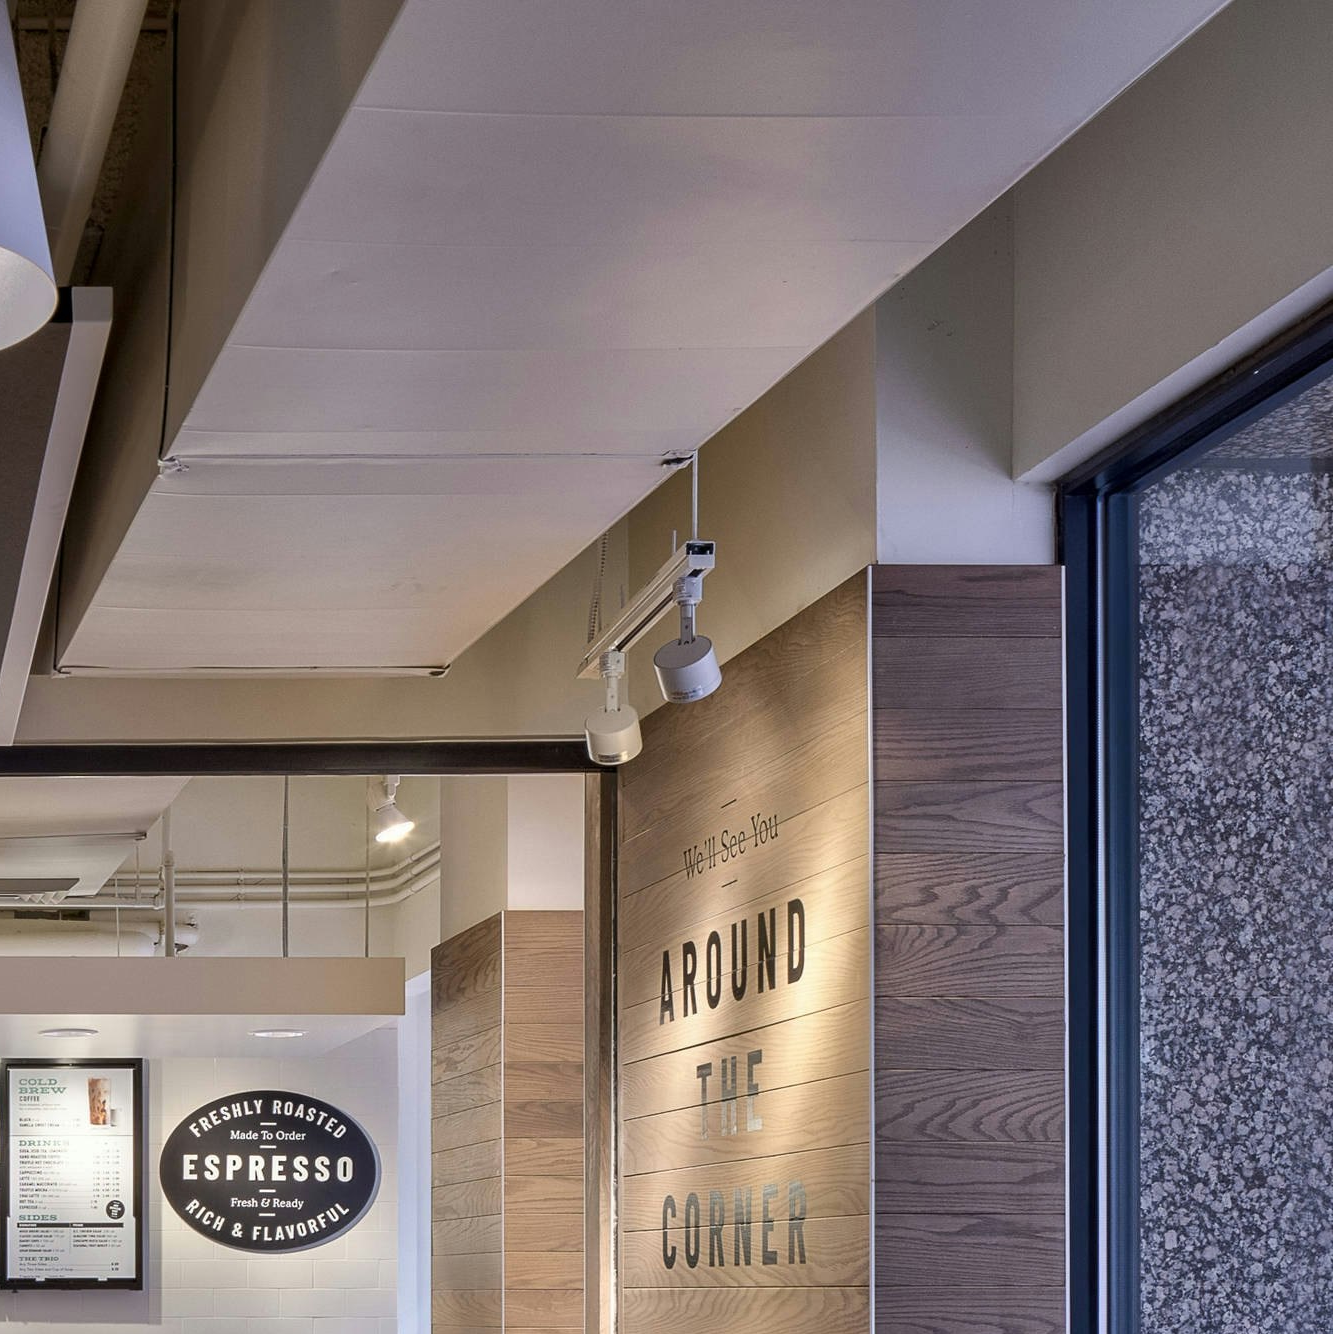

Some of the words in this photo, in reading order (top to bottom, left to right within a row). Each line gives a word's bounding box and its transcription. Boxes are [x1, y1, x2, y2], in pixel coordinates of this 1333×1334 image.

[683, 836, 716, 880] We'll
[721, 828, 747, 860] See
[750, 812, 779, 849] You
[660, 898, 806, 1026] AROUND
[697, 1049, 762, 1140] THE
[189, 1099, 263, 1138] FRESHLY
[272, 1100, 347, 1139] ROASTED
[230, 1131, 259, 1140] Made
[262, 1131, 273, 1140] To
[276, 1131, 306, 1141] Order
[183, 1154, 354, 1182] ESPRESSO
[185, 1199, 226, 1232] RICH
[231, 1222, 242, 1238] &
[252, 1202, 350, 1241] FLAVORFUL
[230, 1198, 258, 1208] Fresh
[261, 1198, 271, 1208] &
[273, 1199, 304, 1210] Ready
[662, 1179, 807, 1270] CORNER
